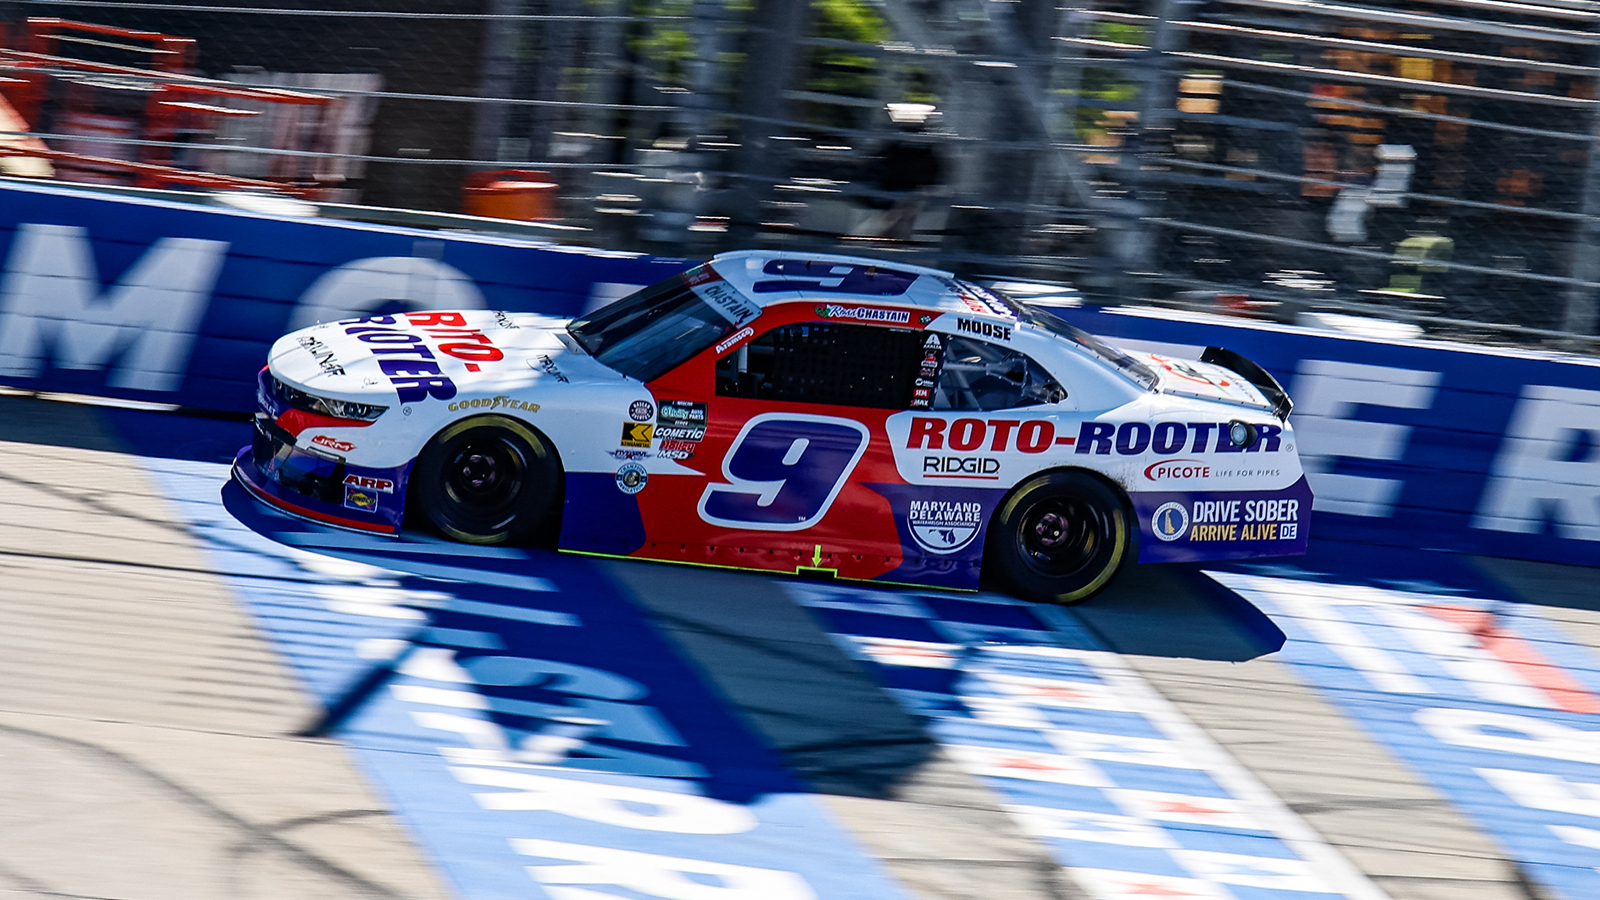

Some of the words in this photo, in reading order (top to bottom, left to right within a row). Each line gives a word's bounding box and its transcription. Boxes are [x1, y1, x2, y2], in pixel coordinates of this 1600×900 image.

[856, 306, 910, 323] CHASTAIN
[957, 317, 1012, 341] MOOSE
[447, 395, 541, 413] GOODYEAR
[655, 426, 704, 440] COMETIC
[657, 449, 690, 460] MSD
[698, 413, 871, 530] 9
[923, 456, 1000, 474] RIDGID
[1158, 466, 1211, 480] PICOTE
[1215, 469, 1233, 478] LIFE
[1236, 469, 1253, 478] FOR
[1256, 469, 1281, 478] PIPES
[343, 474, 393, 491] ARP
[909, 500, 982, 514] MARYLAND
[1192, 500, 1242, 523] DRIVE
[1244, 499, 1299, 522] SOBER
[908, 510, 981, 522] DELAWARE
[1189, 524, 1238, 541] ARRIVE
[1240, 523, 1278, 541] ALIVE
[1281, 524, 1297, 539] DE
